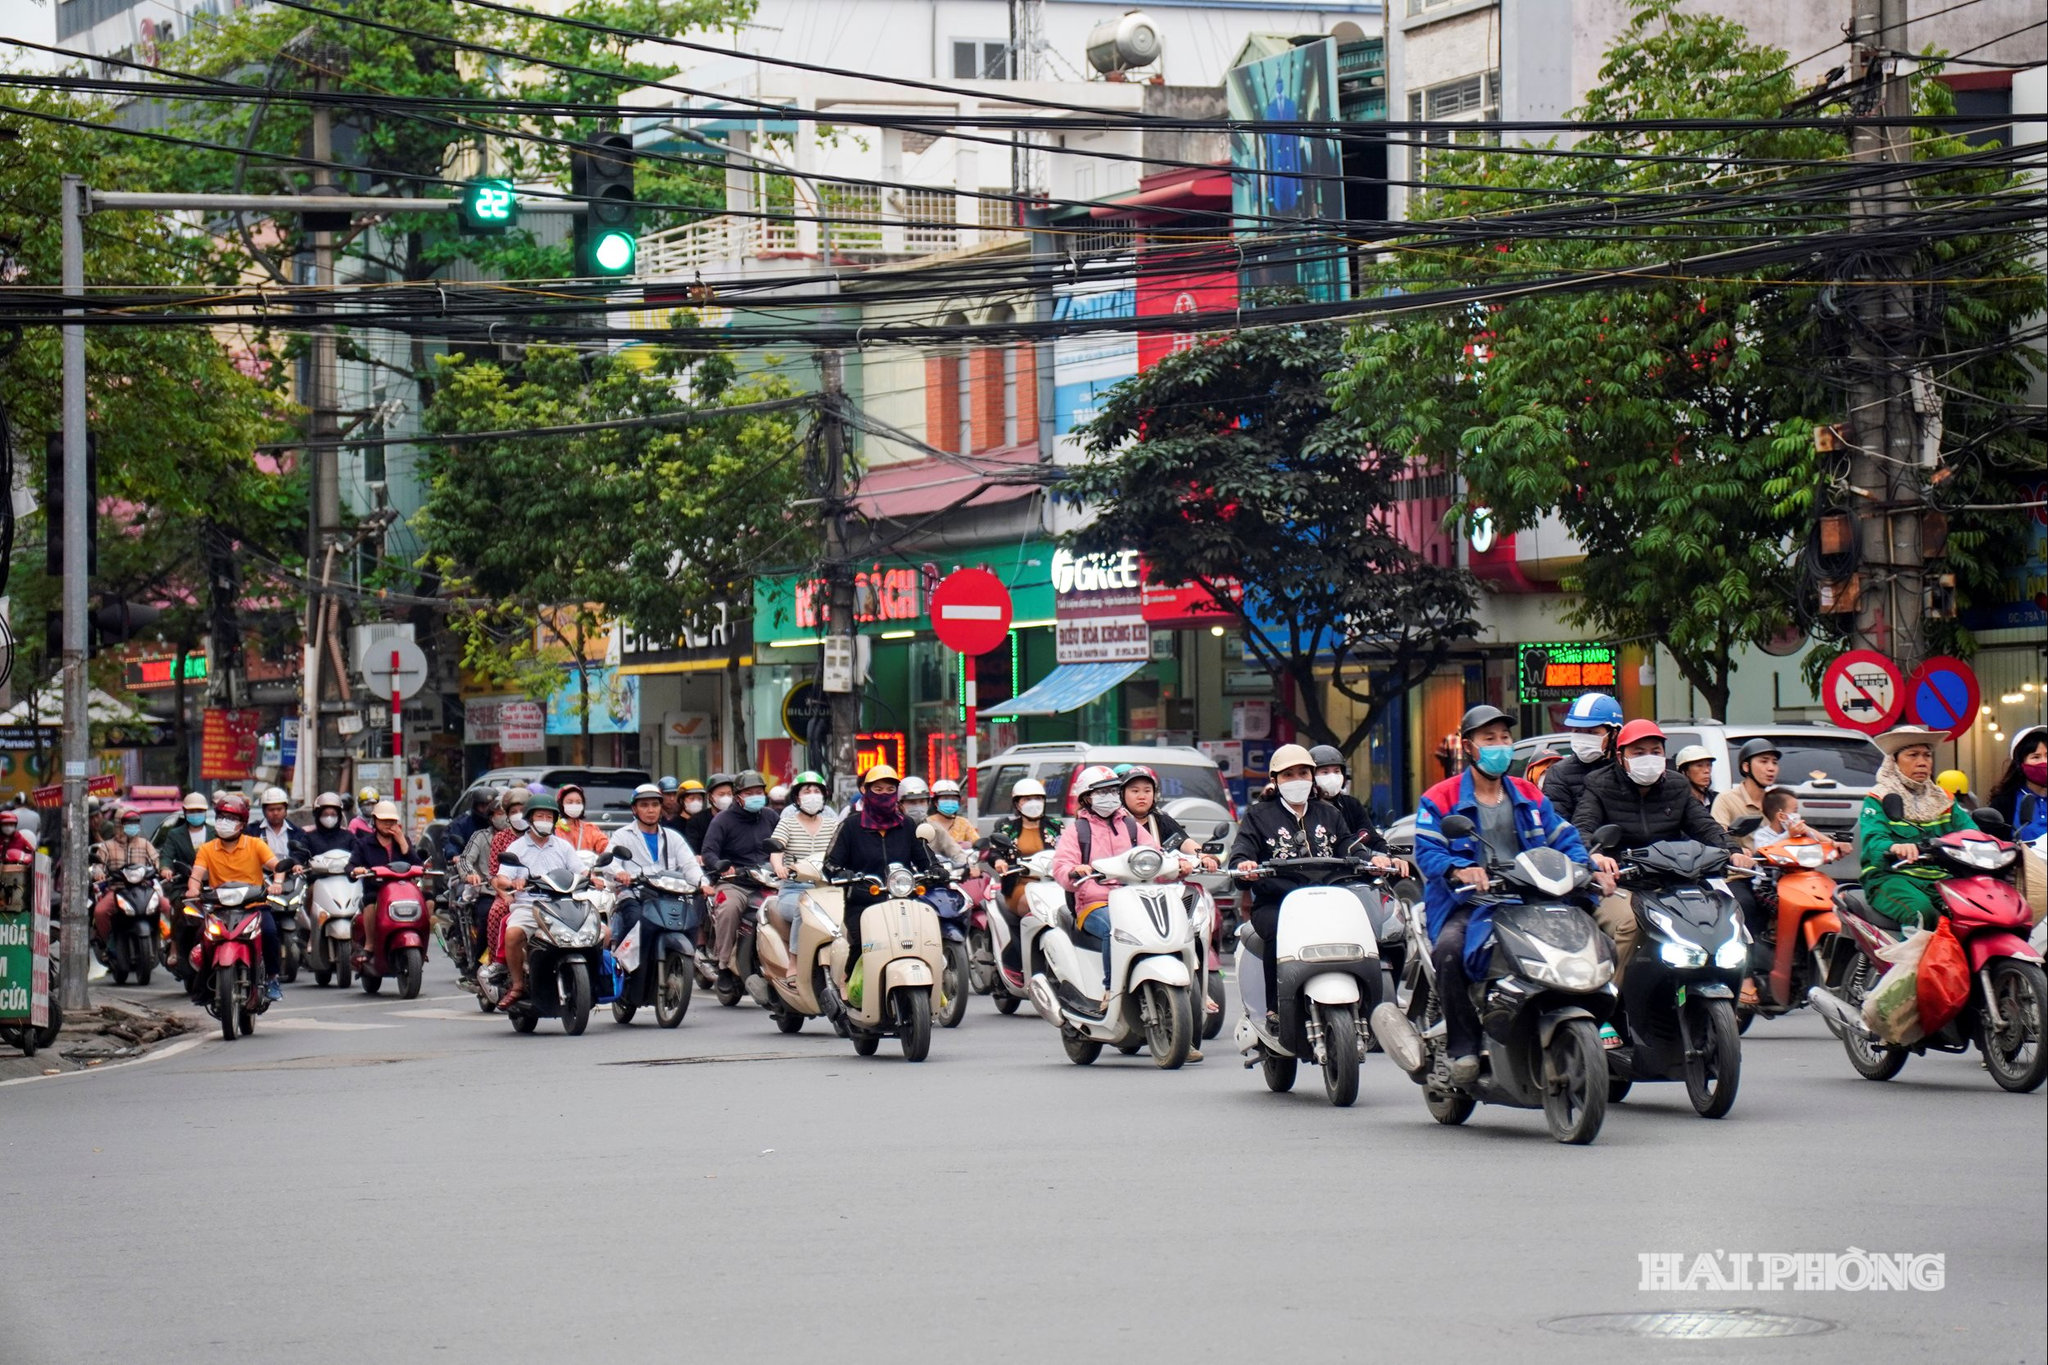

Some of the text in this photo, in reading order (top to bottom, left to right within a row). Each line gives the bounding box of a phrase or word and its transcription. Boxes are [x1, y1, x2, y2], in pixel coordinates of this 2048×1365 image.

[475, 188, 509, 218] 22
[1525, 687, 1538, 697] 75
[0, 981, 28, 1011] CỬA
